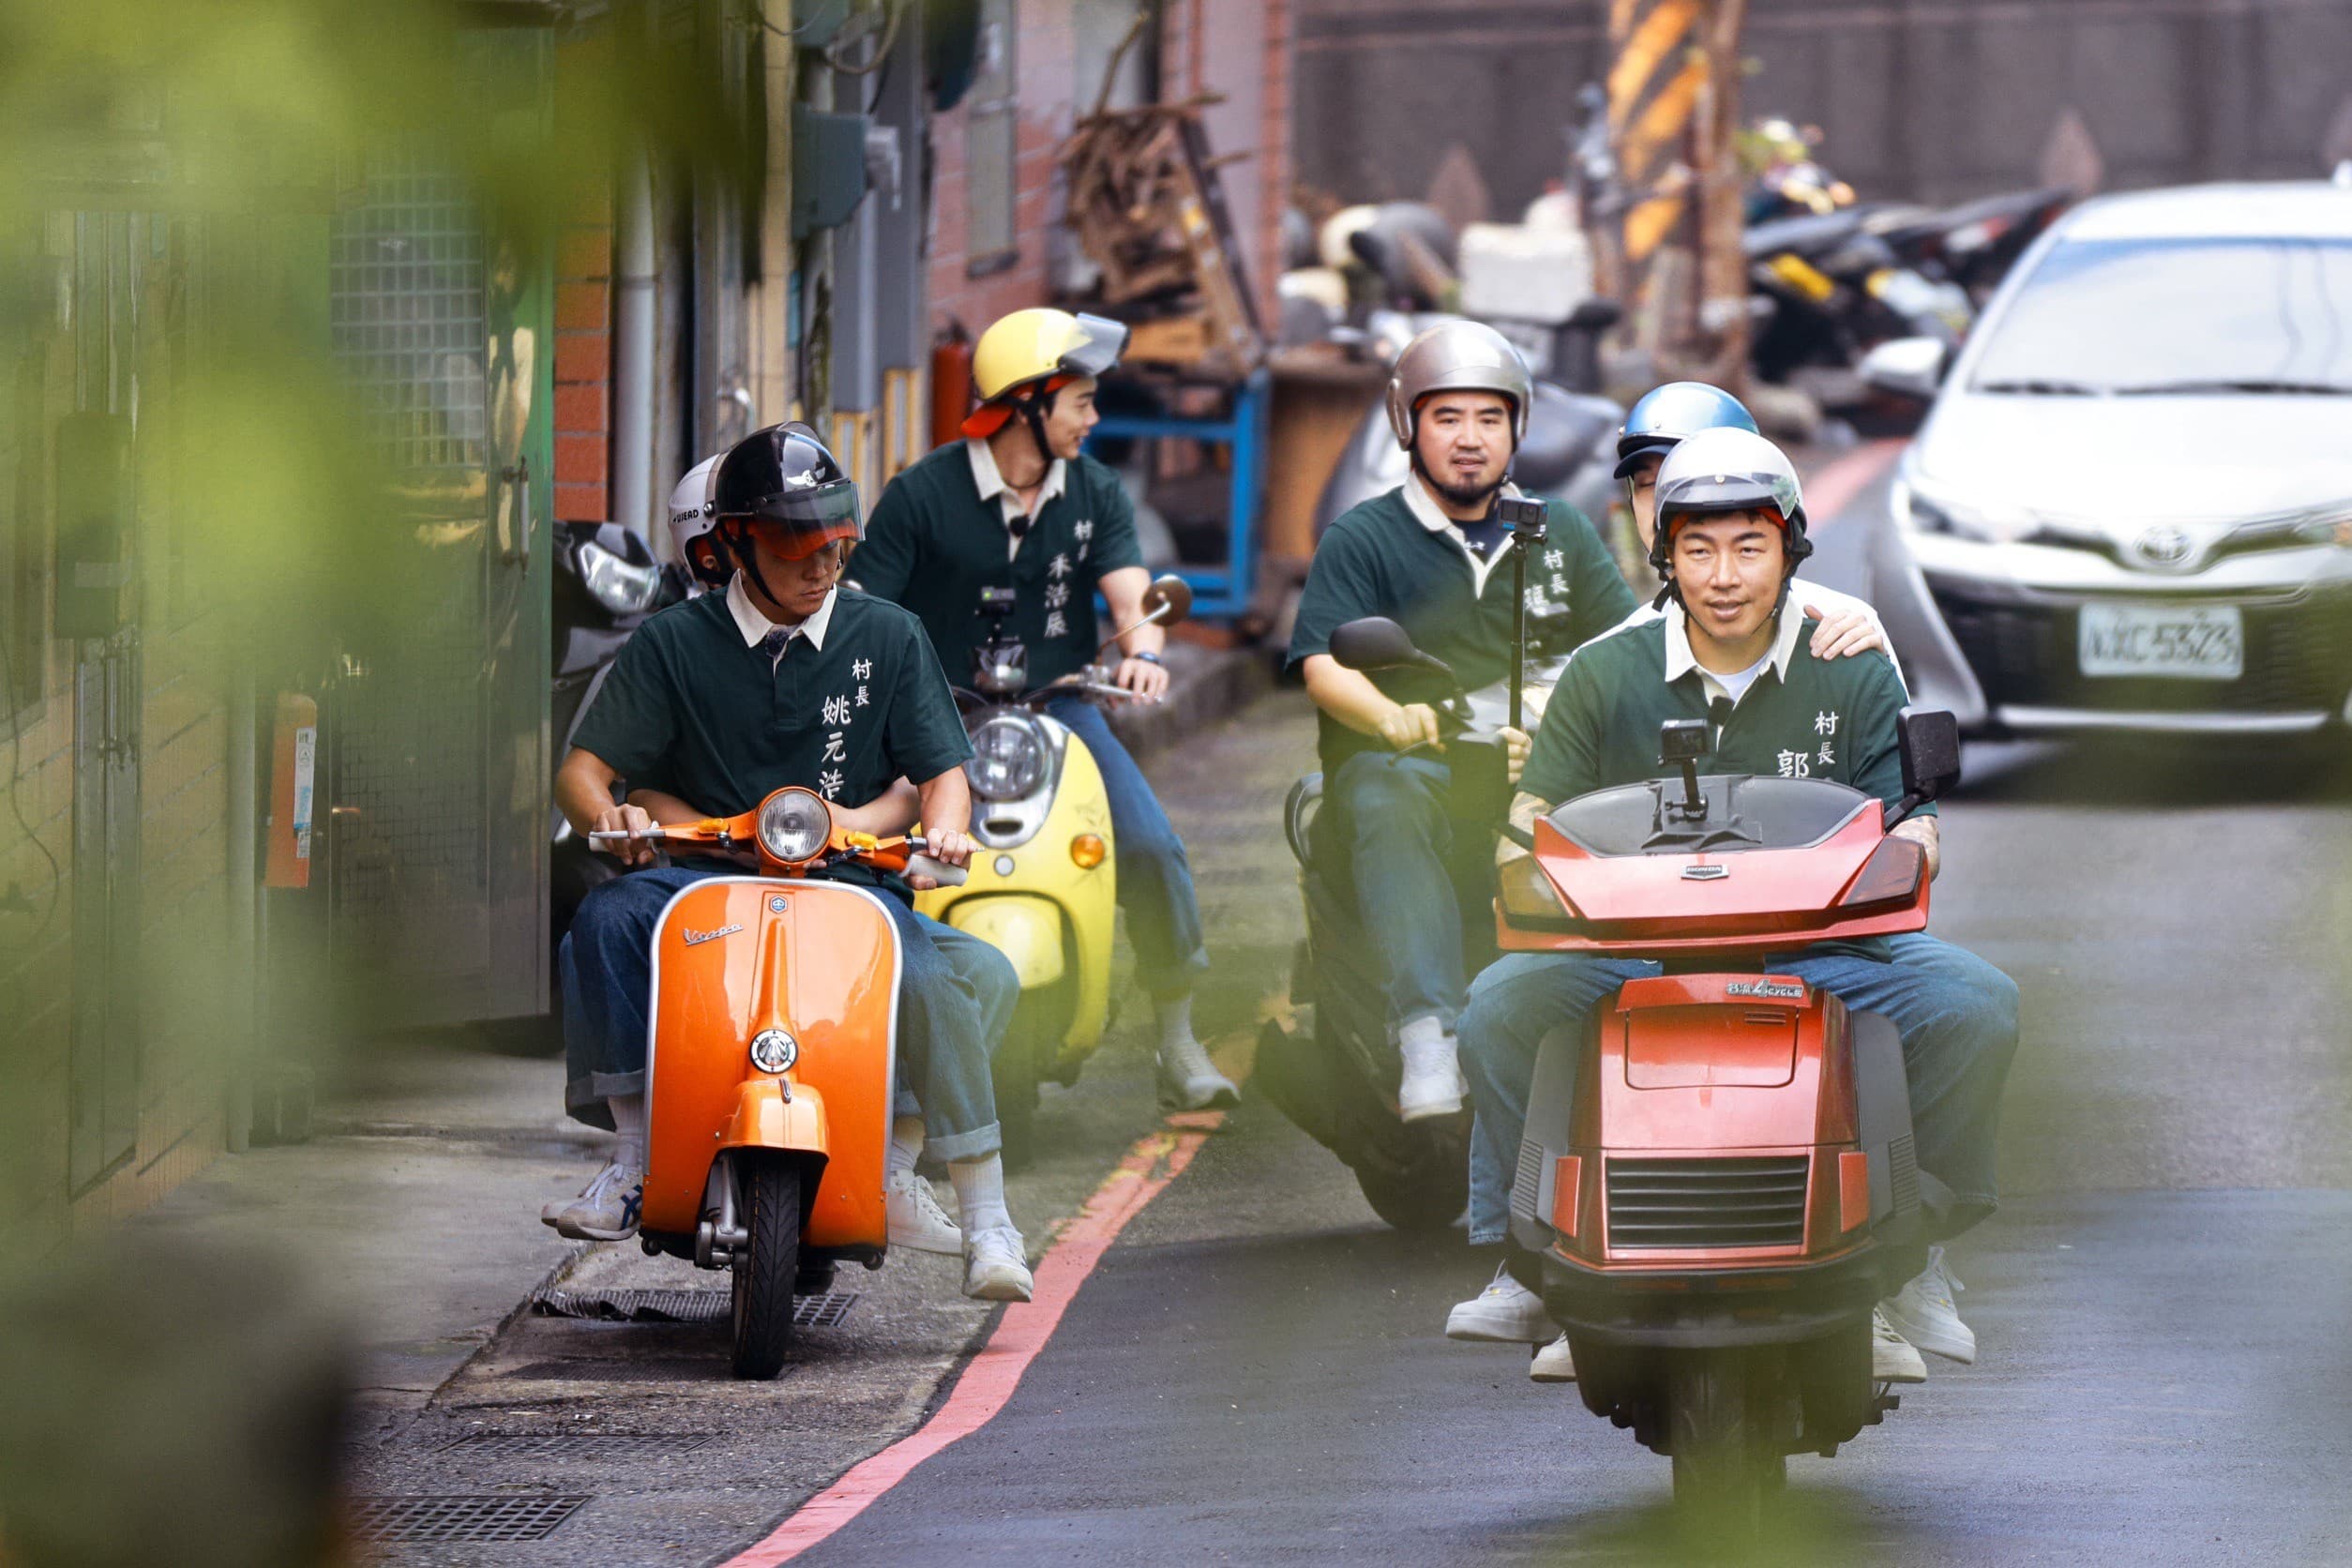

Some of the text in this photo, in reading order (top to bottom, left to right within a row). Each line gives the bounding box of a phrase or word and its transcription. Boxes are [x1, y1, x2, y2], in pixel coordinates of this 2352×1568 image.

[1544, 550, 1570, 595] 村長
[852, 657, 872, 707] 村長
[818, 694, 852, 801] 姚元浩
[1815, 710, 1839, 765] 村長
[1777, 748, 1810, 777] 郭
[684, 924, 744, 946] Vespa
